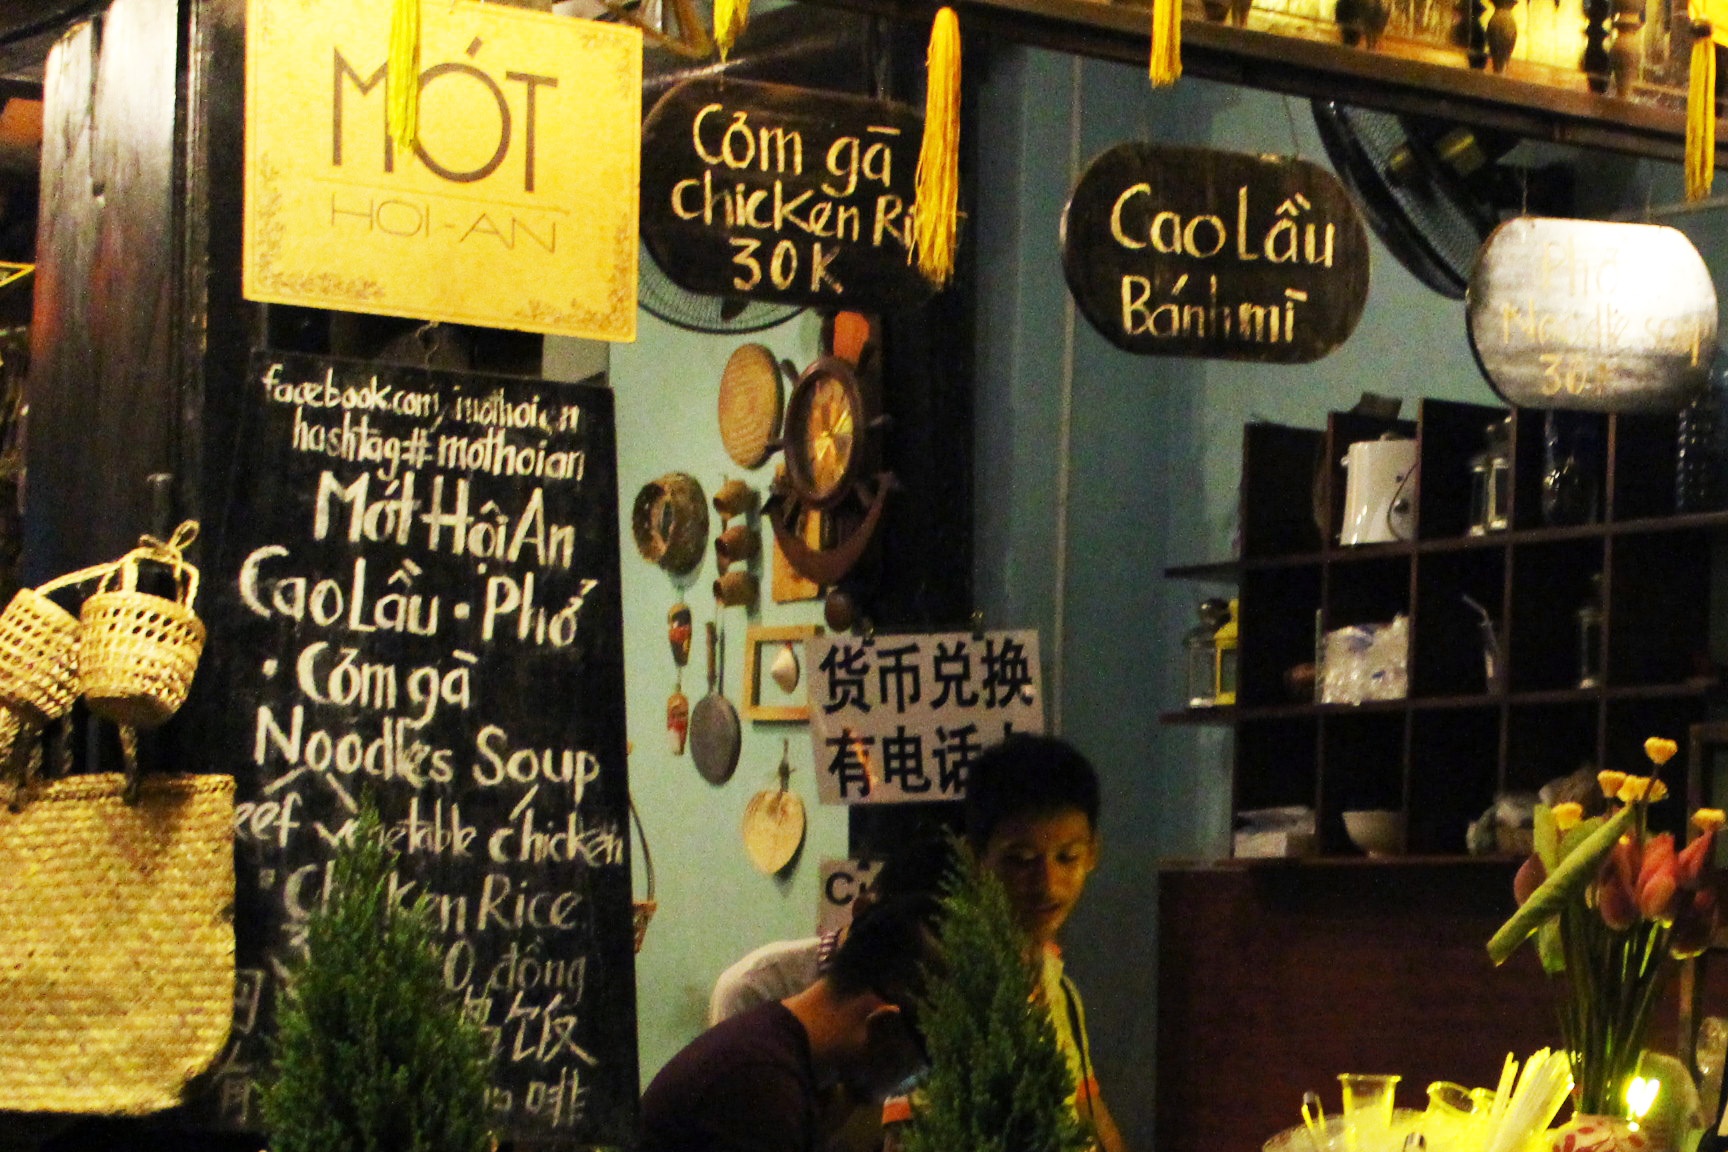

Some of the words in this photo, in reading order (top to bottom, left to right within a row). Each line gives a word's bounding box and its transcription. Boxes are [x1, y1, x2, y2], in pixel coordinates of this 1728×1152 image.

[332, 36, 560, 193] MÓT
[1110, 182, 1228, 258] Cao
[1236, 185, 1336, 269] Lầu
[419, 474, 510, 576] Hội
[506, 486, 577, 569] An
[239, 543, 345, 627] Cao
[348, 556, 440, 637] Lầu
[481, 570, 600, 649] Phở
[818, 637, 1034, 716] 货币兑换
[471, 723, 602, 805] Soup
[825, 721, 1014, 799] 有电话
[477, 872, 584, 932] Rice
